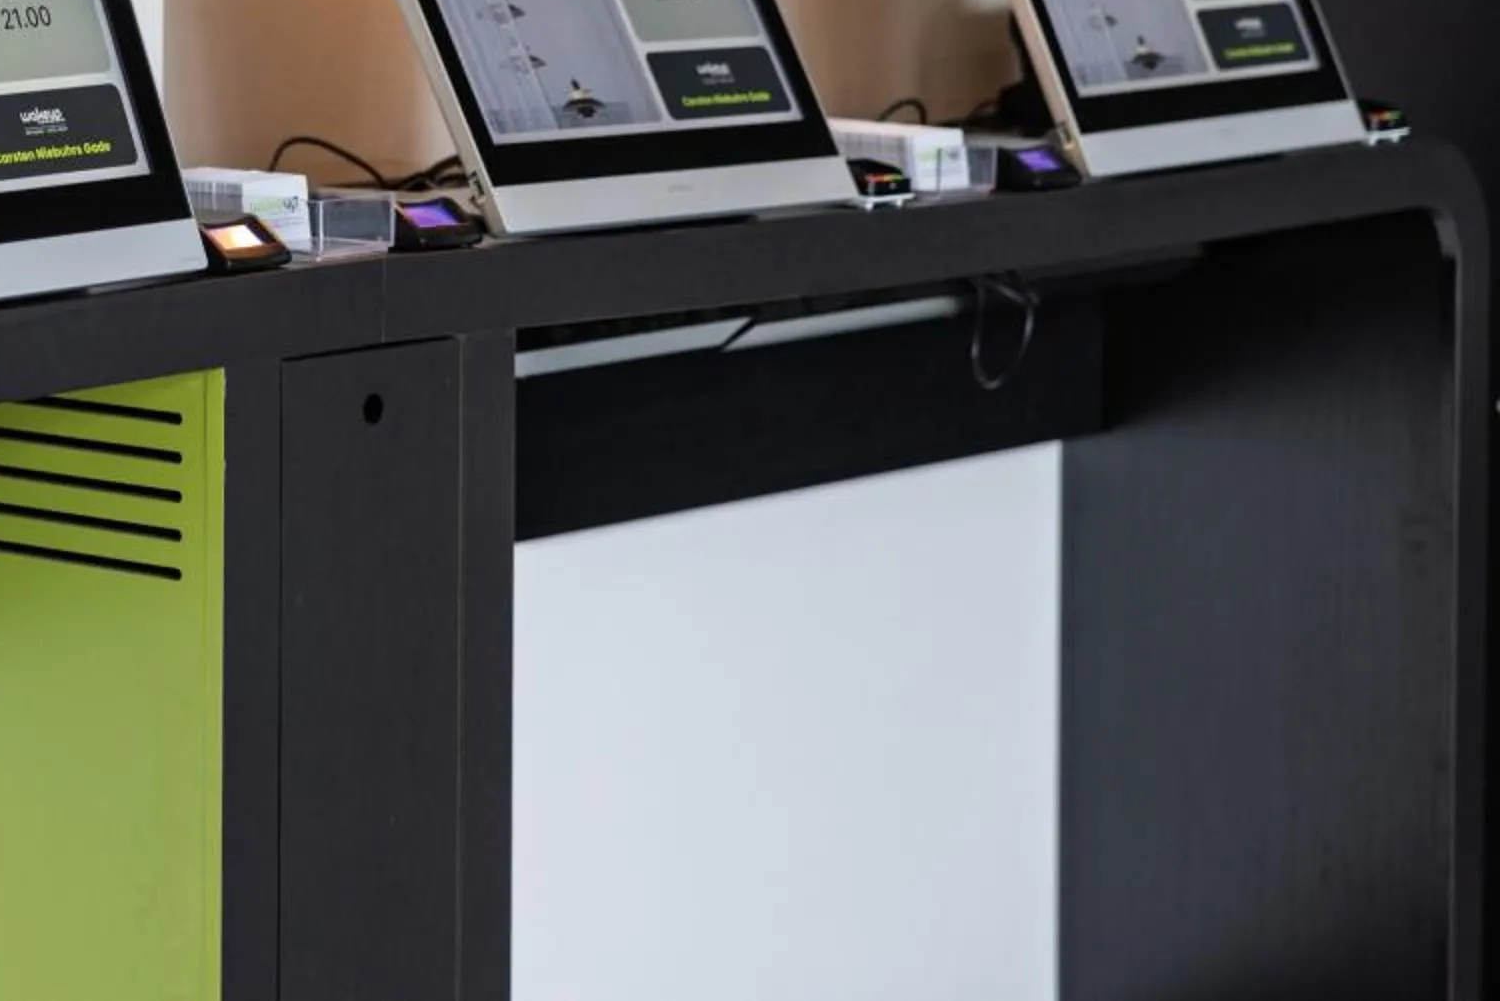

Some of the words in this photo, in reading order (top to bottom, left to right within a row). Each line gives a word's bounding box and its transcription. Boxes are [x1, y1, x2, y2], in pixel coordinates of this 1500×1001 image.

[2, 4, 52, 31] 21.00
[35, 143, 82, 160] Niebuhrs
[82, 140, 112, 155] Gade
